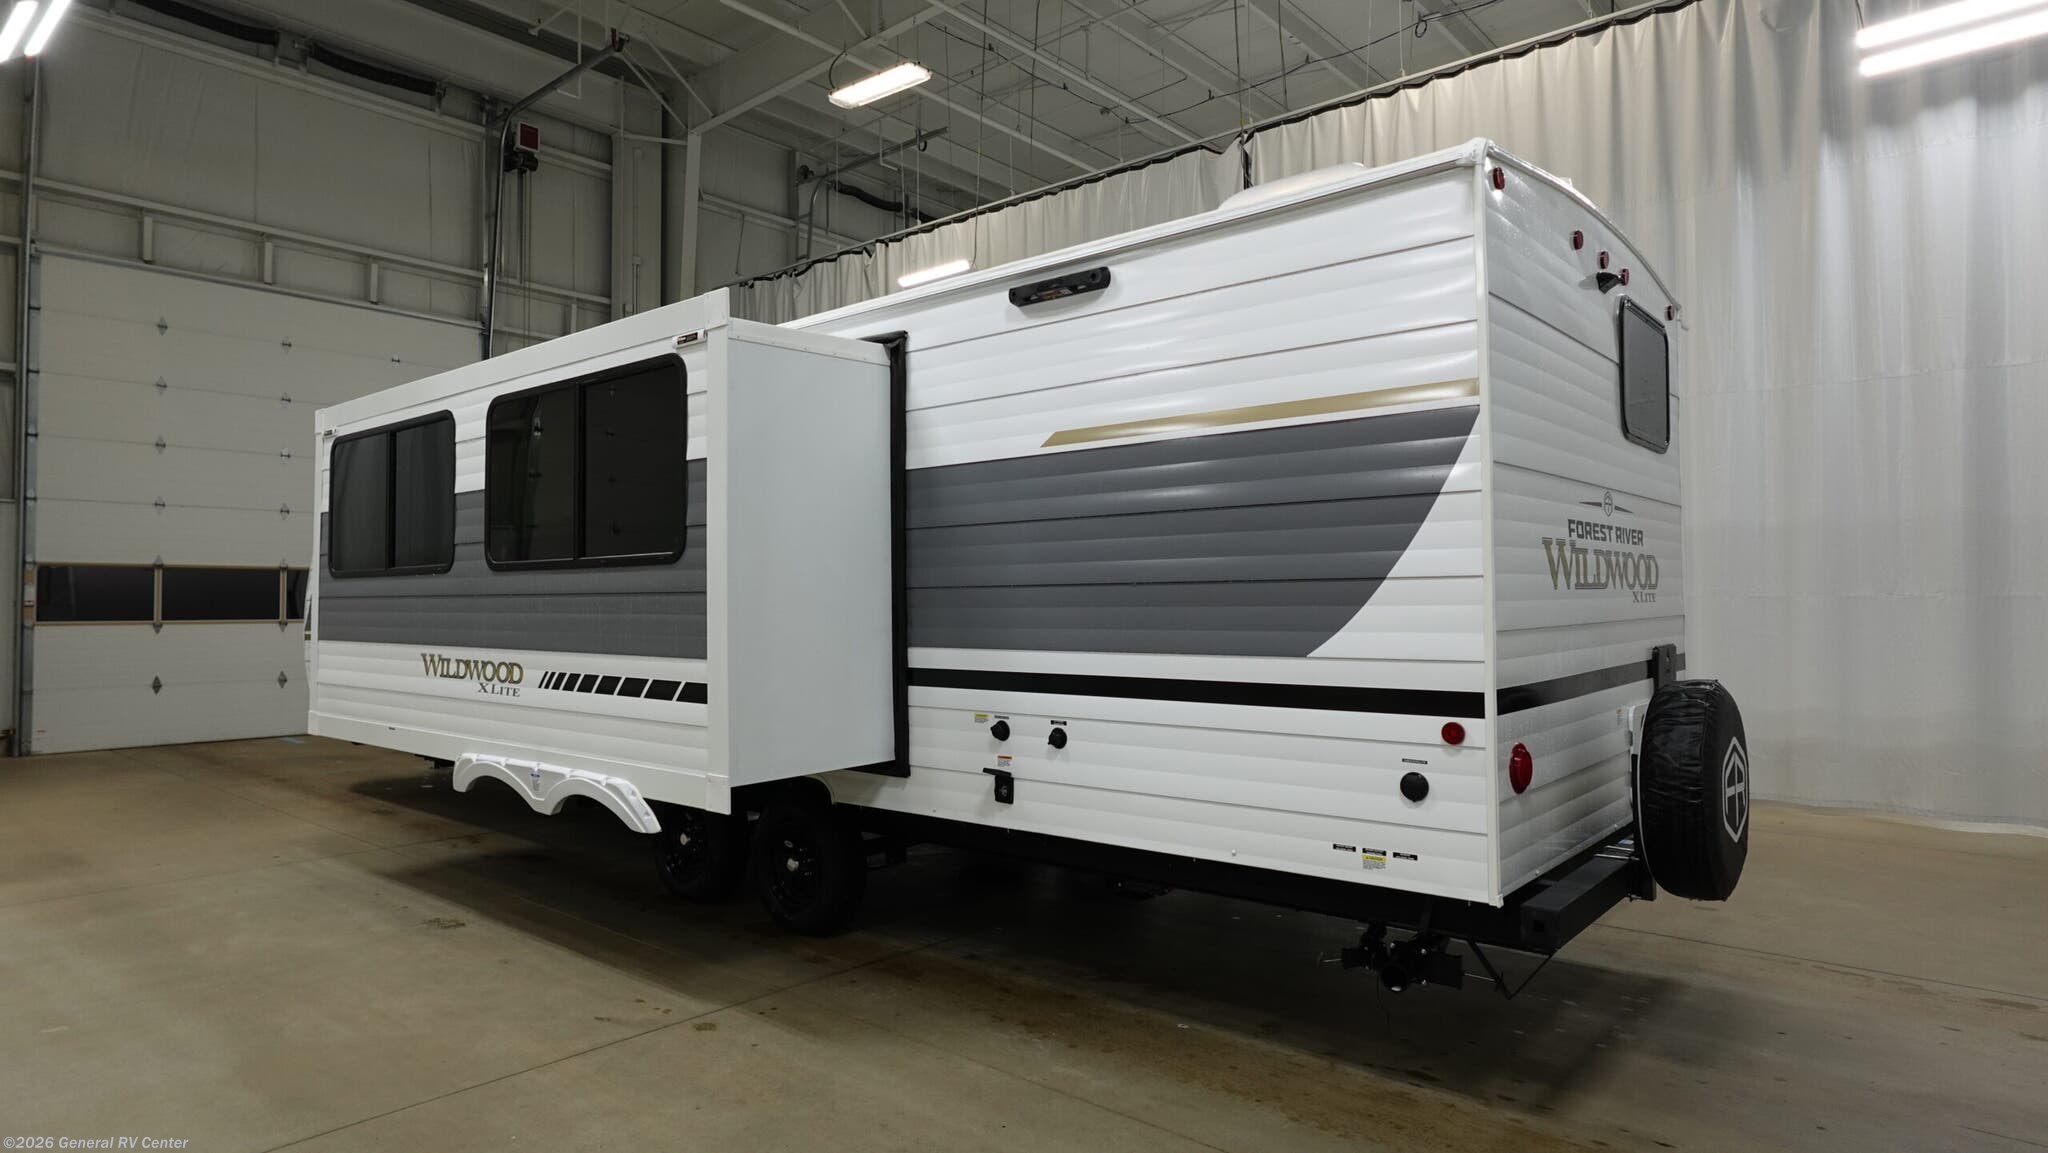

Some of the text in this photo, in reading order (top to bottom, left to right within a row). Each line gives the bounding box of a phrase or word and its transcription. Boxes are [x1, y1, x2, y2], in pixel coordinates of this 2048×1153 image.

[1567, 518, 1644, 547] FOREST RIVER
[1542, 537, 1659, 590] WILDWOOD
[421, 653, 524, 684] WILDWOOD
